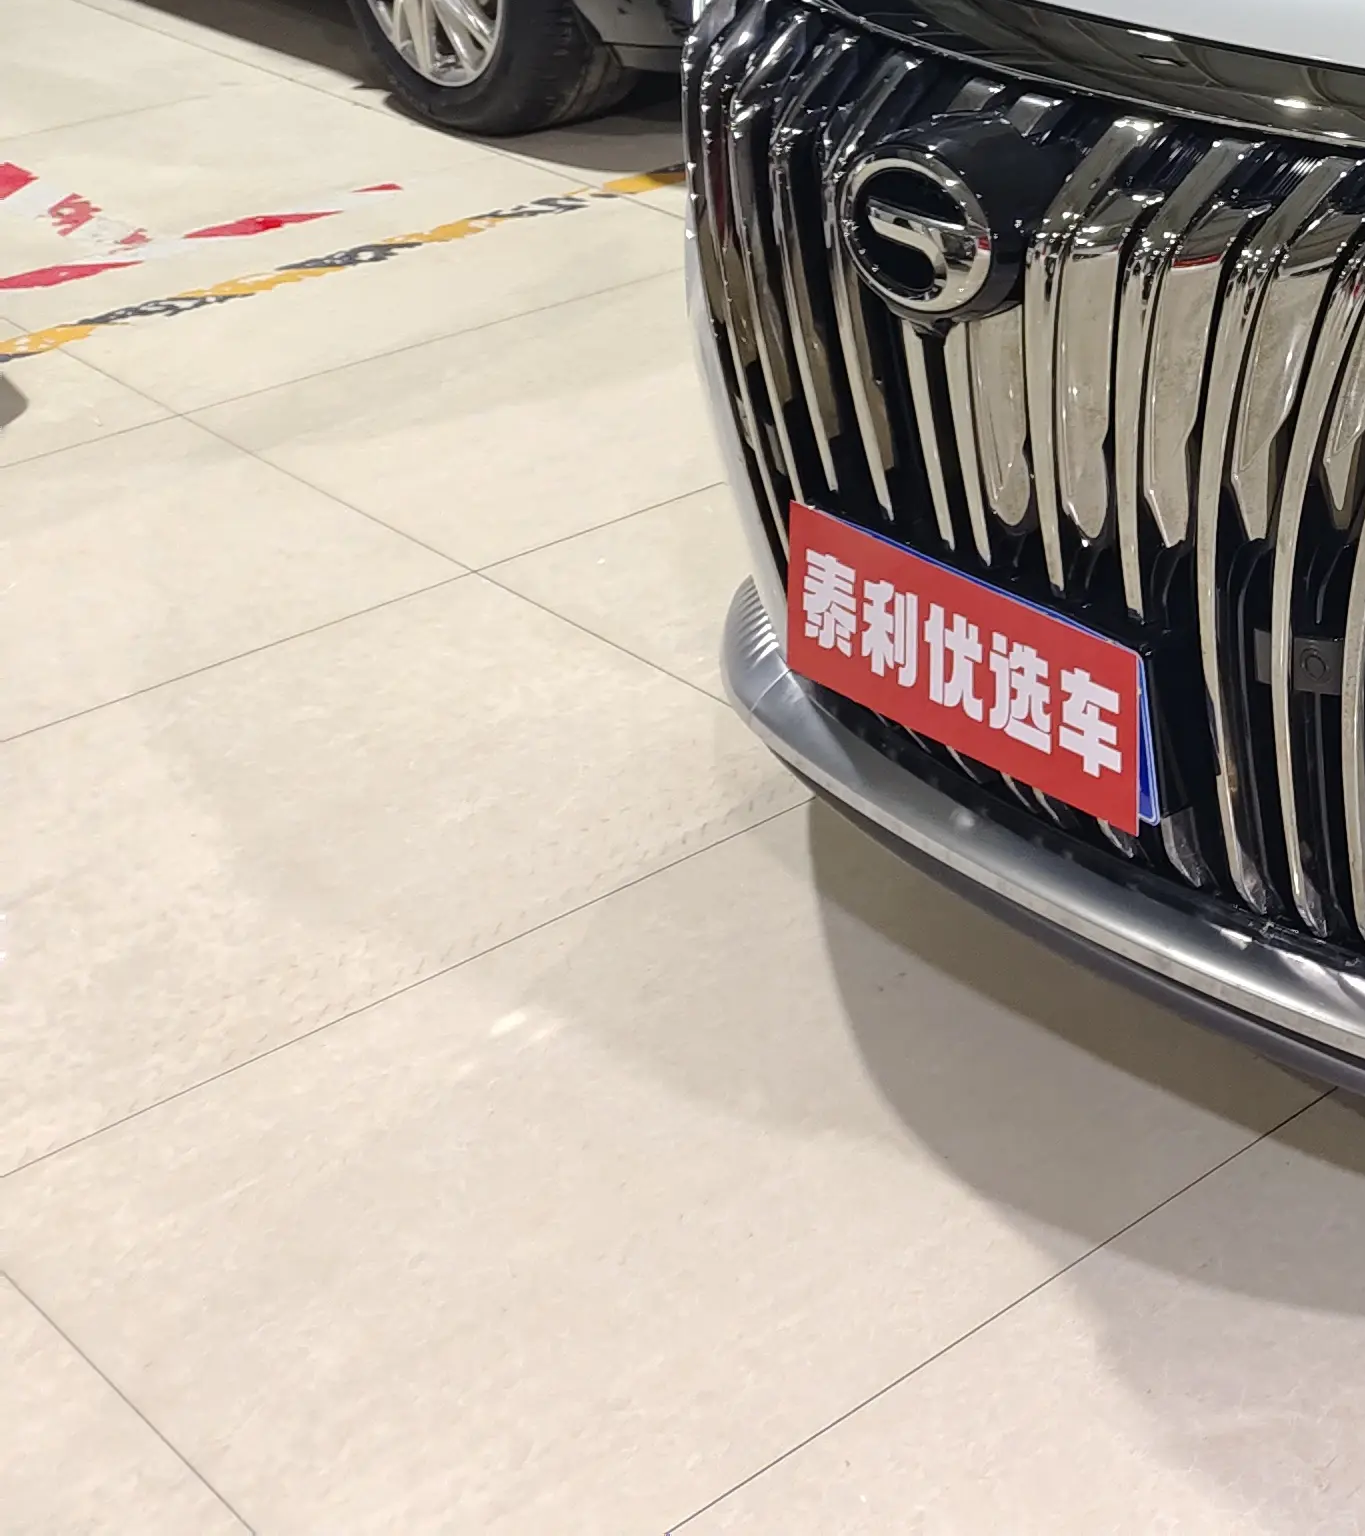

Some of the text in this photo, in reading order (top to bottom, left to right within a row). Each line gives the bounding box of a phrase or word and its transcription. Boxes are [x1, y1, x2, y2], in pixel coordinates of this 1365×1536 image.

[802, 547, 1123, 779] 泰利优选车
